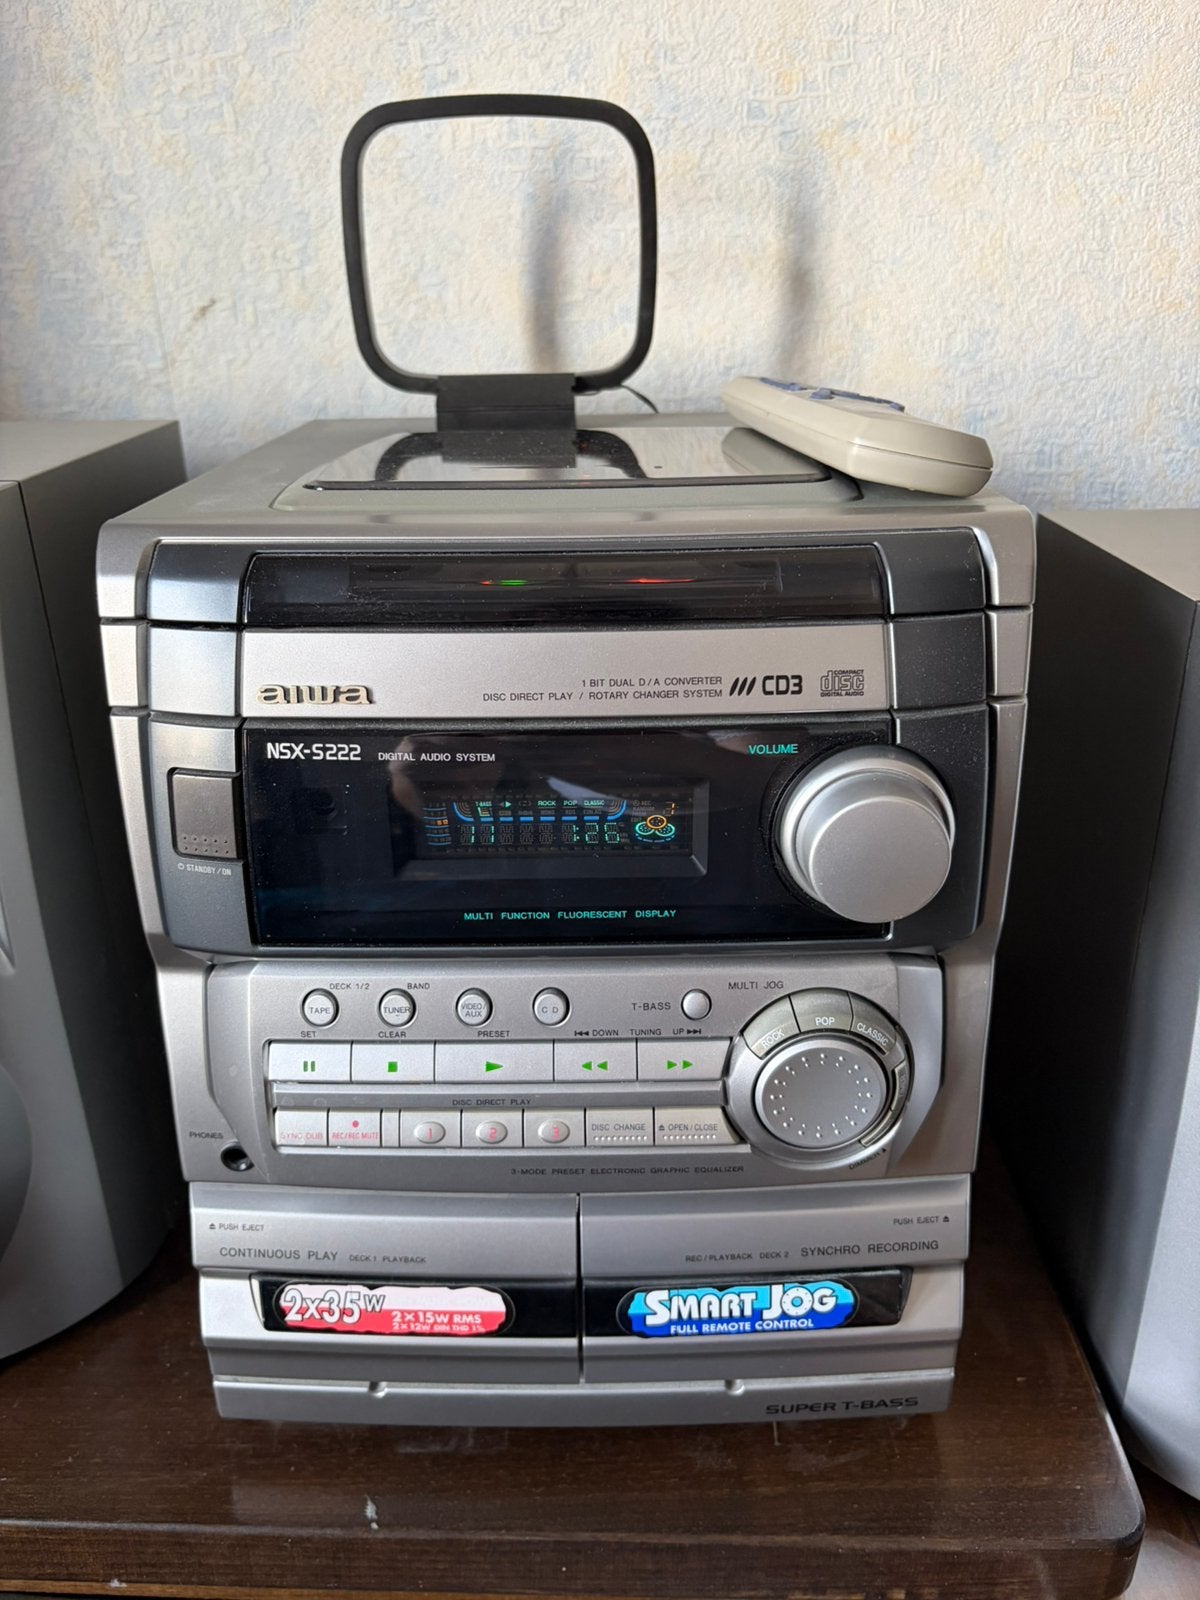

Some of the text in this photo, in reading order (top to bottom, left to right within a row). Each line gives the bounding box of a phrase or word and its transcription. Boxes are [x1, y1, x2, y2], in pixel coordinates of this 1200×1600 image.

[582, 679, 587, 687] 1
[590, 678, 605, 687] BIT
[609, 677, 635, 687] DUAL
[664, 675, 723, 686] CONVERTER
[761, 674, 804, 696] CD3
[256, 684, 374, 704] aiwa
[482, 692, 506, 702] DISC
[509, 692, 544, 702] DIRECT
[547, 691, 573, 702] PLAY
[588, 690, 630, 701] ROTARY
[632, 689, 680, 700] CHANGER
[682, 688, 723, 699] SYSTEM
[266, 742, 496, 762] NSX-S222 DIGITAL AUDIO SYSTEM
[747, 743, 799, 756] VOLUME
[463, 909, 677, 921] MULTI FUNCTION FLUORESCENT DISPLAY
[329, 982, 370, 990] DECK 1/2
[407, 982, 431, 990] BAND
[728, 980, 784, 990] MULTI JOG
[308, 1006, 332, 1015] TAPE
[383, 1005, 412, 1015] TUNER
[631, 1001, 672, 1012] T-BASS
[465, 1010, 482, 1018] AUX
[815, 1016, 835, 1026] POP
[300, 1030, 317, 1038] SET
[378, 1030, 407, 1039] CLEAR
[477, 1030, 511, 1038] PRESET
[591, 1027, 685, 1037] DOWN TUNING UP
[856, 1022, 889, 1047] CLASSIC
[761, 1029, 786, 1049] ROCK
[452, 1098, 532, 1106] DISC DIRECT PLAY
[591, 1122, 646, 1132] DISC CHANGE
[188, 1132, 224, 1140] PHONES
[305, 1132, 324, 1140] DUB
[361, 1131, 380, 1140] MUTE
[426, 1127, 433, 1141] 1
[487, 1127, 497, 1141] 2
[551, 1126, 561, 1141] 3
[510, 1165, 744, 1176] 3-MODE PRESET ELECTRONIC GRAPHIC EQUALIZER
[893, 1215, 940, 1226] PUSH EJECT
[218, 1222, 265, 1232] PUSH EJECT
[219, 1246, 301, 1260] CONTINUOUS
[307, 1249, 339, 1262] PLAY
[349, 1253, 371, 1262] DECK
[382, 1255, 427, 1264] PLAYBACK
[759, 1251, 781, 1260] DECK
[784, 1251, 789, 1259] 2
[800, 1244, 861, 1258] SYNCHRO
[867, 1239, 939, 1254] RECORDING
[762, 1284, 838, 1320] JOG
[452, 1313, 482, 1324] RMS
[670, 1318, 814, 1335] FULL REMOTE CONTROL
[765, 1397, 920, 1415] SUPER T-BASS
